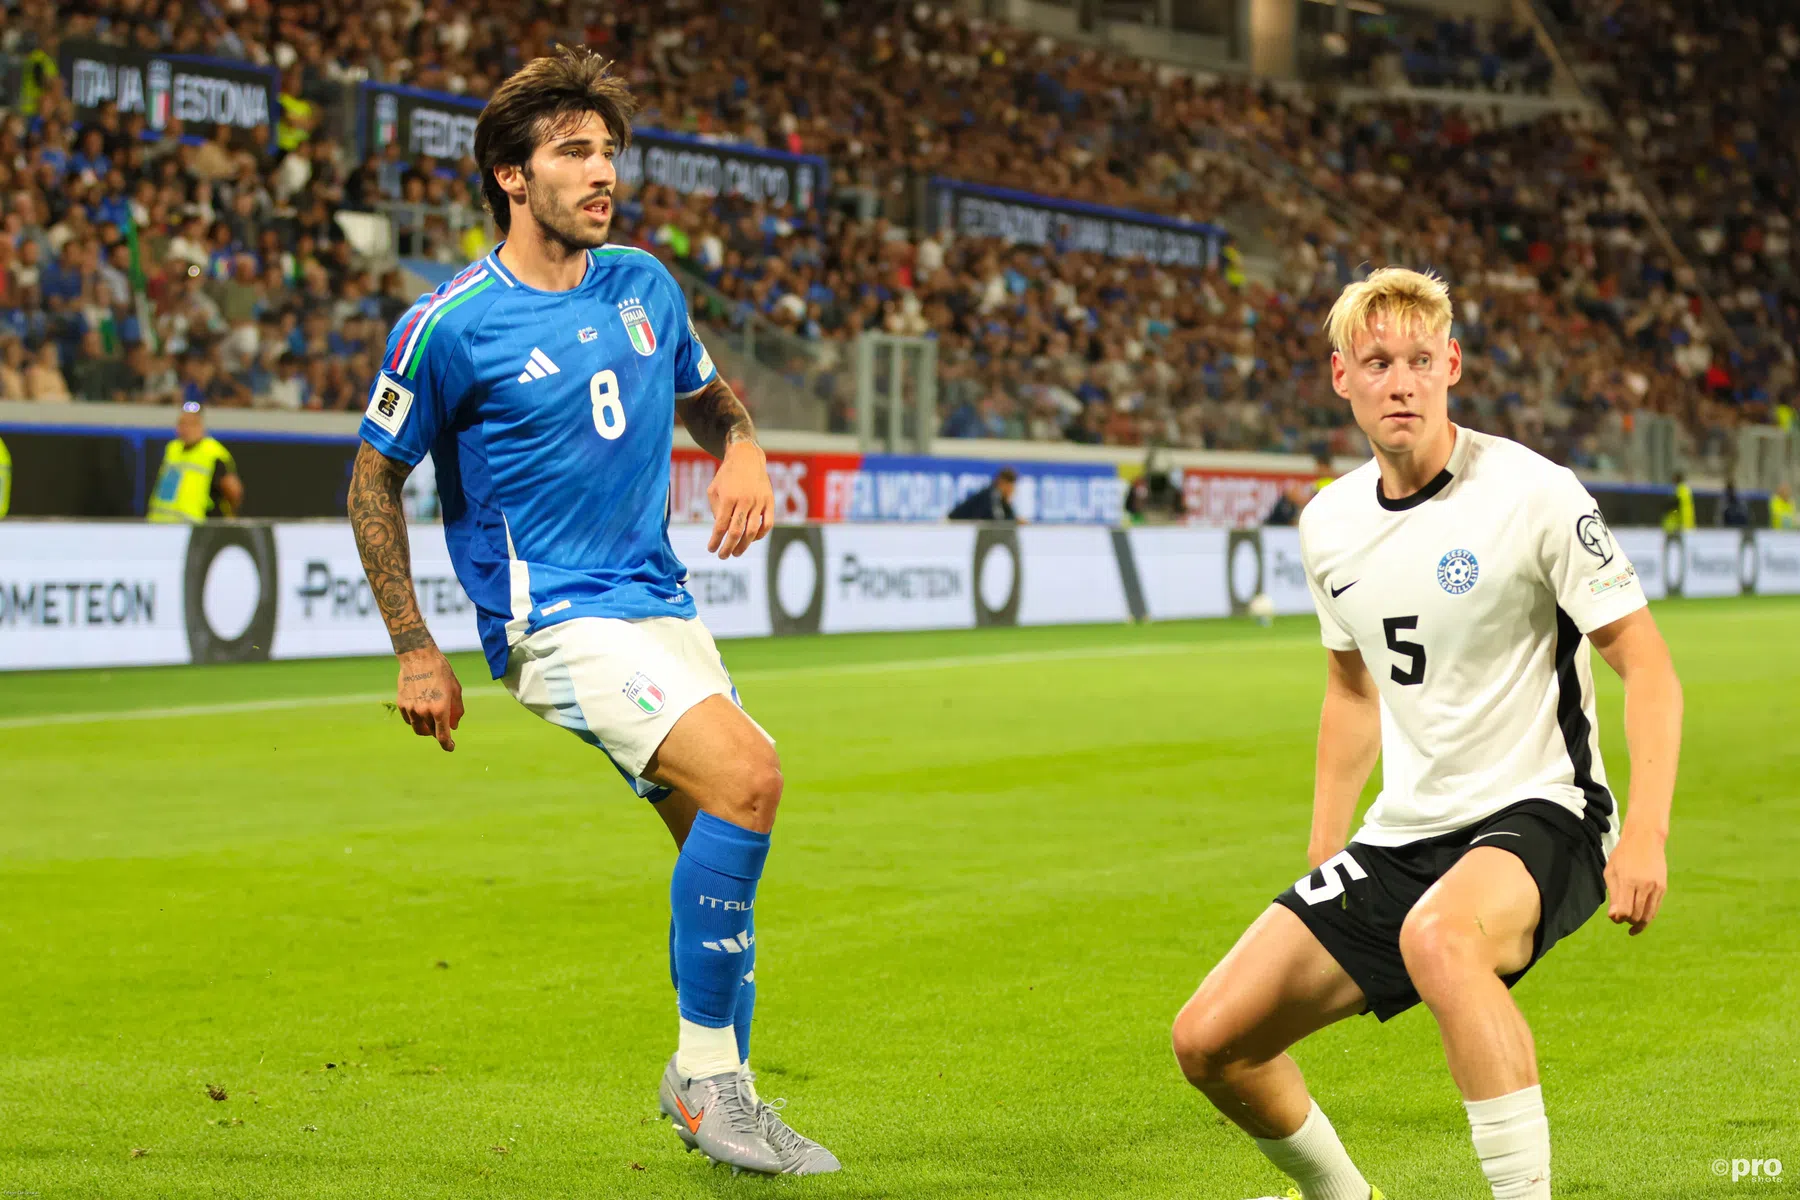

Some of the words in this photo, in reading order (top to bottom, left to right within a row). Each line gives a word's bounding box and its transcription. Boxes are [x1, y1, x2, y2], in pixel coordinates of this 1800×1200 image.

[590, 369, 627, 440] 8
[1383, 615, 1426, 685] 5
[1295, 850, 1368, 906] 5
